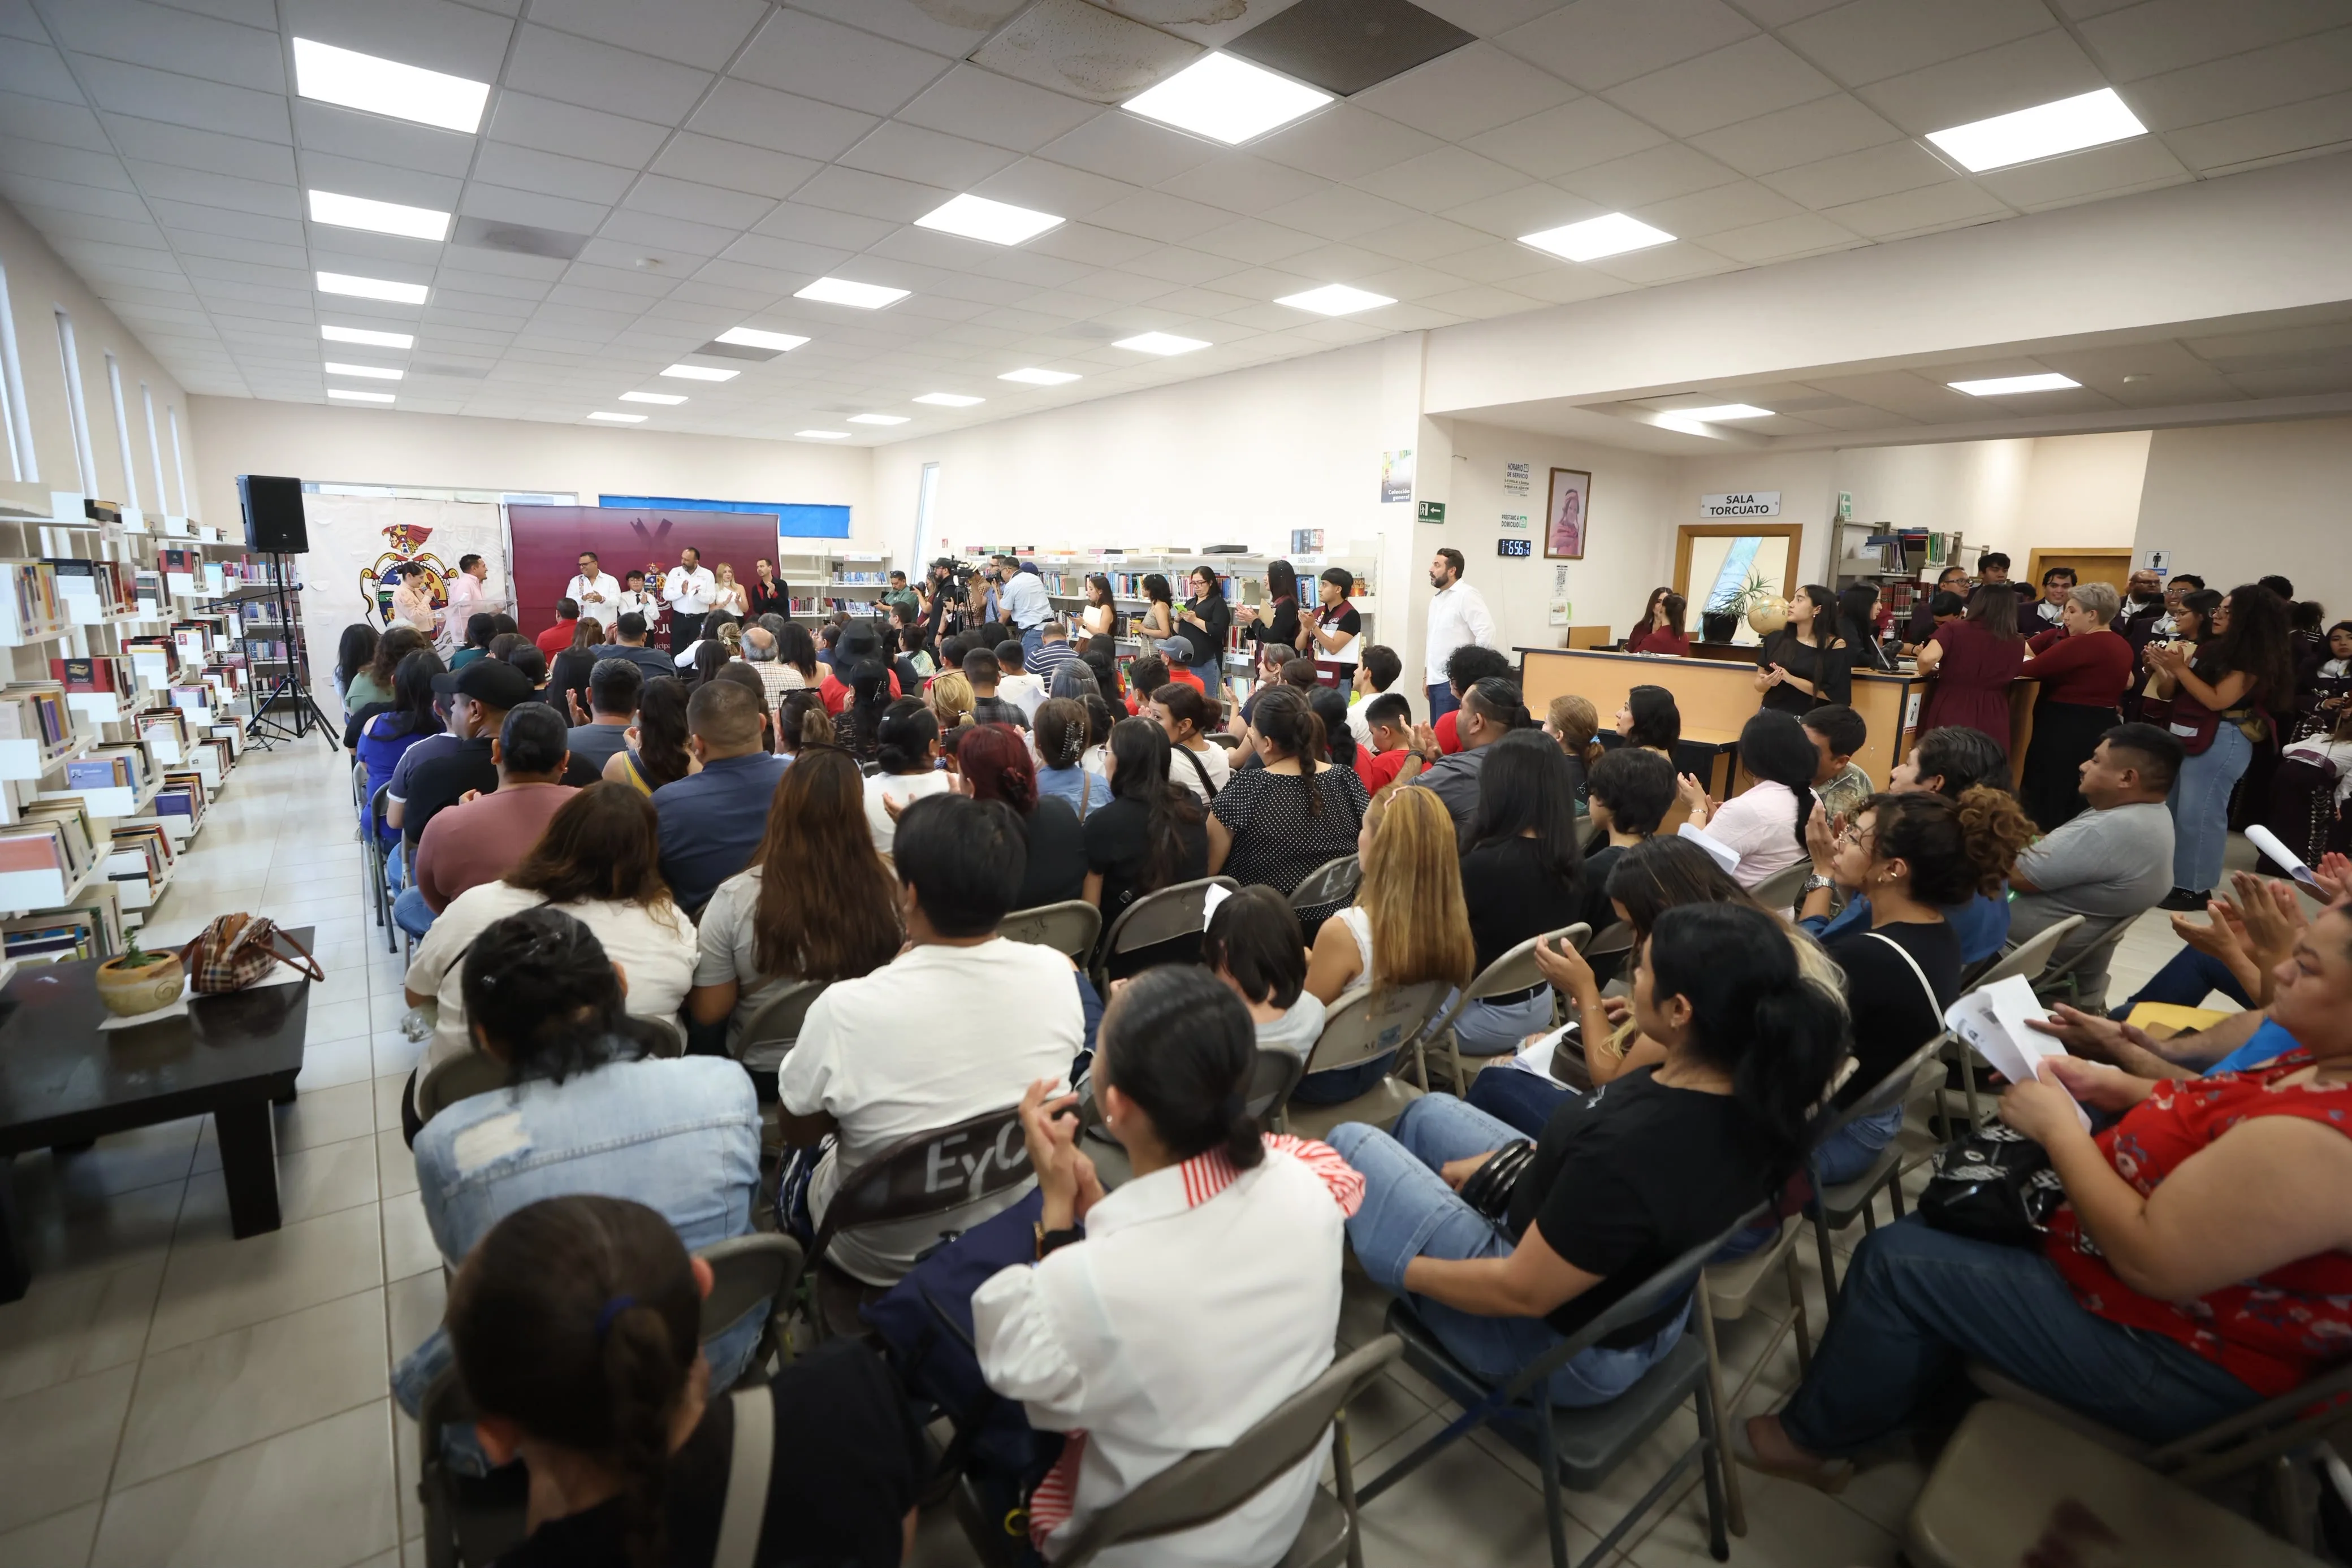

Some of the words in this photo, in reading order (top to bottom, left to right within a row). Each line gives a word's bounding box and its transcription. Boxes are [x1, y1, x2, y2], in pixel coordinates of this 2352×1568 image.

[1507, 463, 1523, 471] HORARIO
[1726, 495, 1754, 504] SALA
[1710, 505, 1769, 515] TORCUATO
